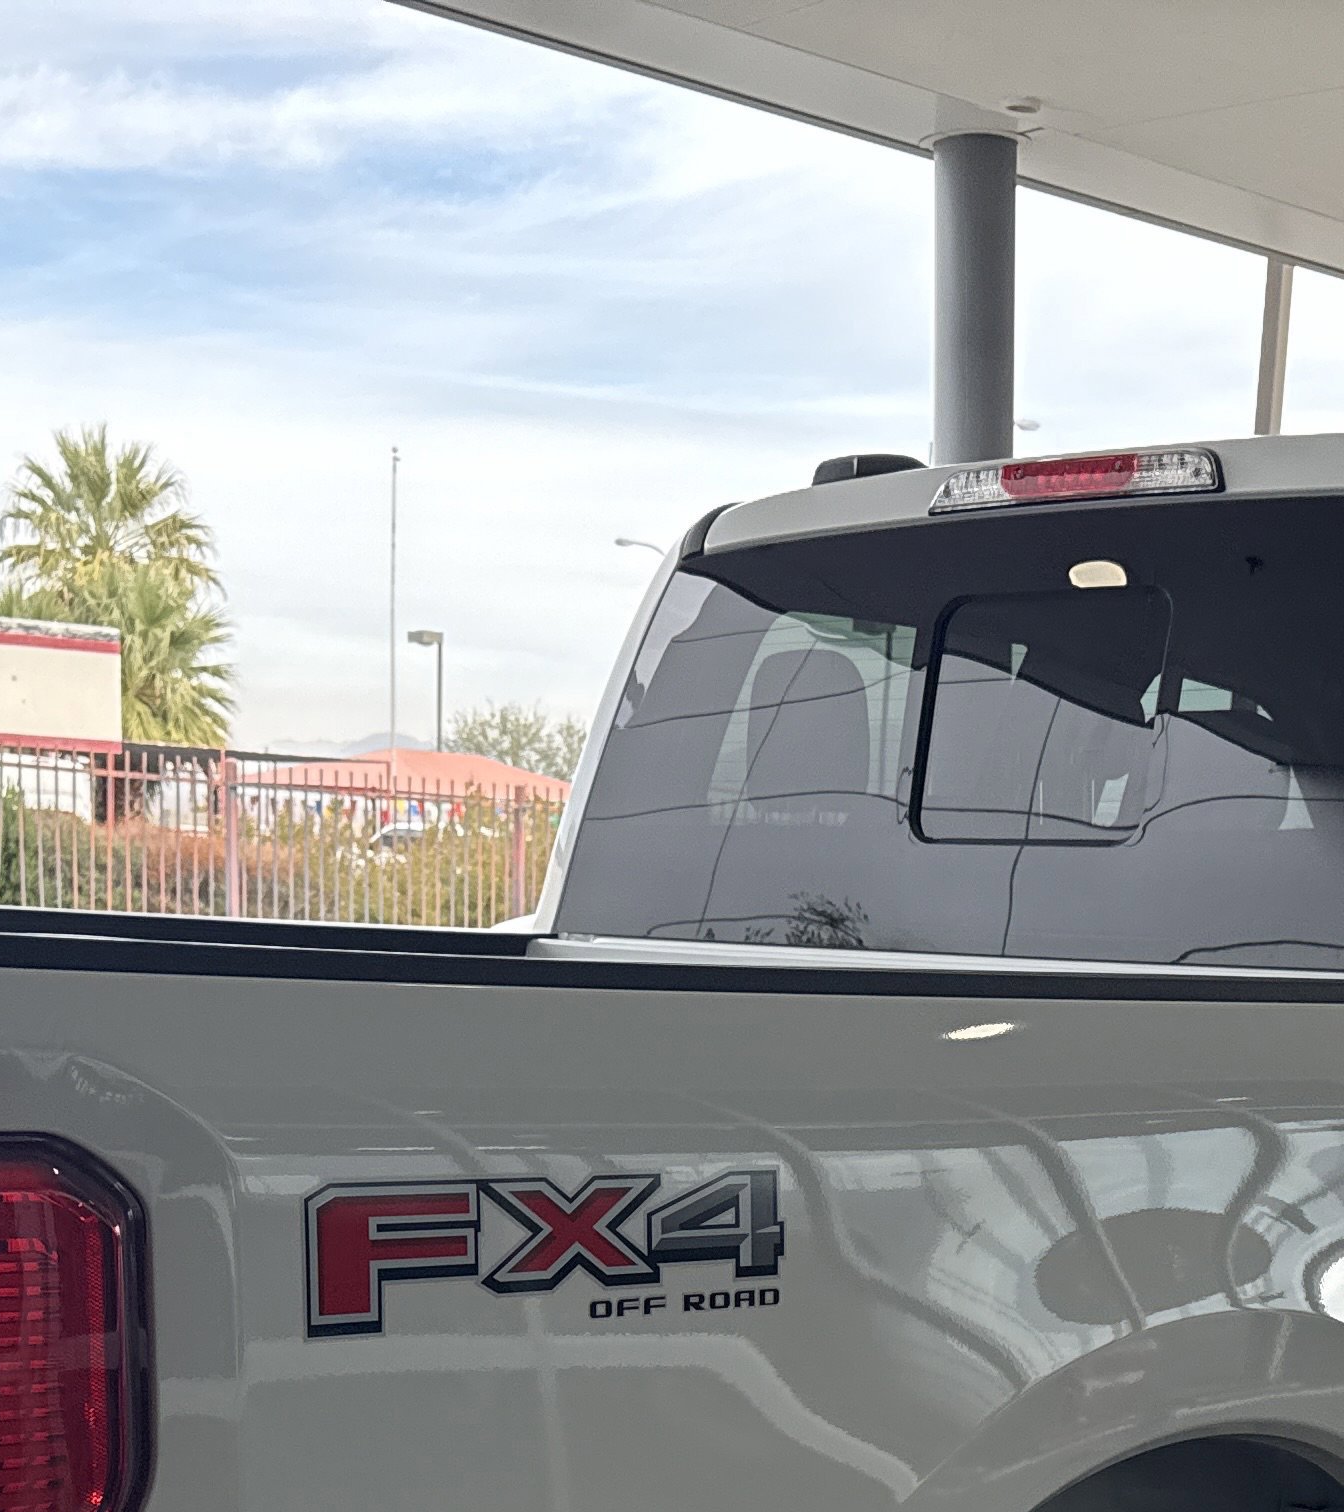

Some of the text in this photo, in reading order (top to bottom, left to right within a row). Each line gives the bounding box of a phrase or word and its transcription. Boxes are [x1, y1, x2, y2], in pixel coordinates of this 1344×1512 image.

[304, 1169, 785, 1339] FX4
[589, 1287, 780, 1319] OFF ROAD
